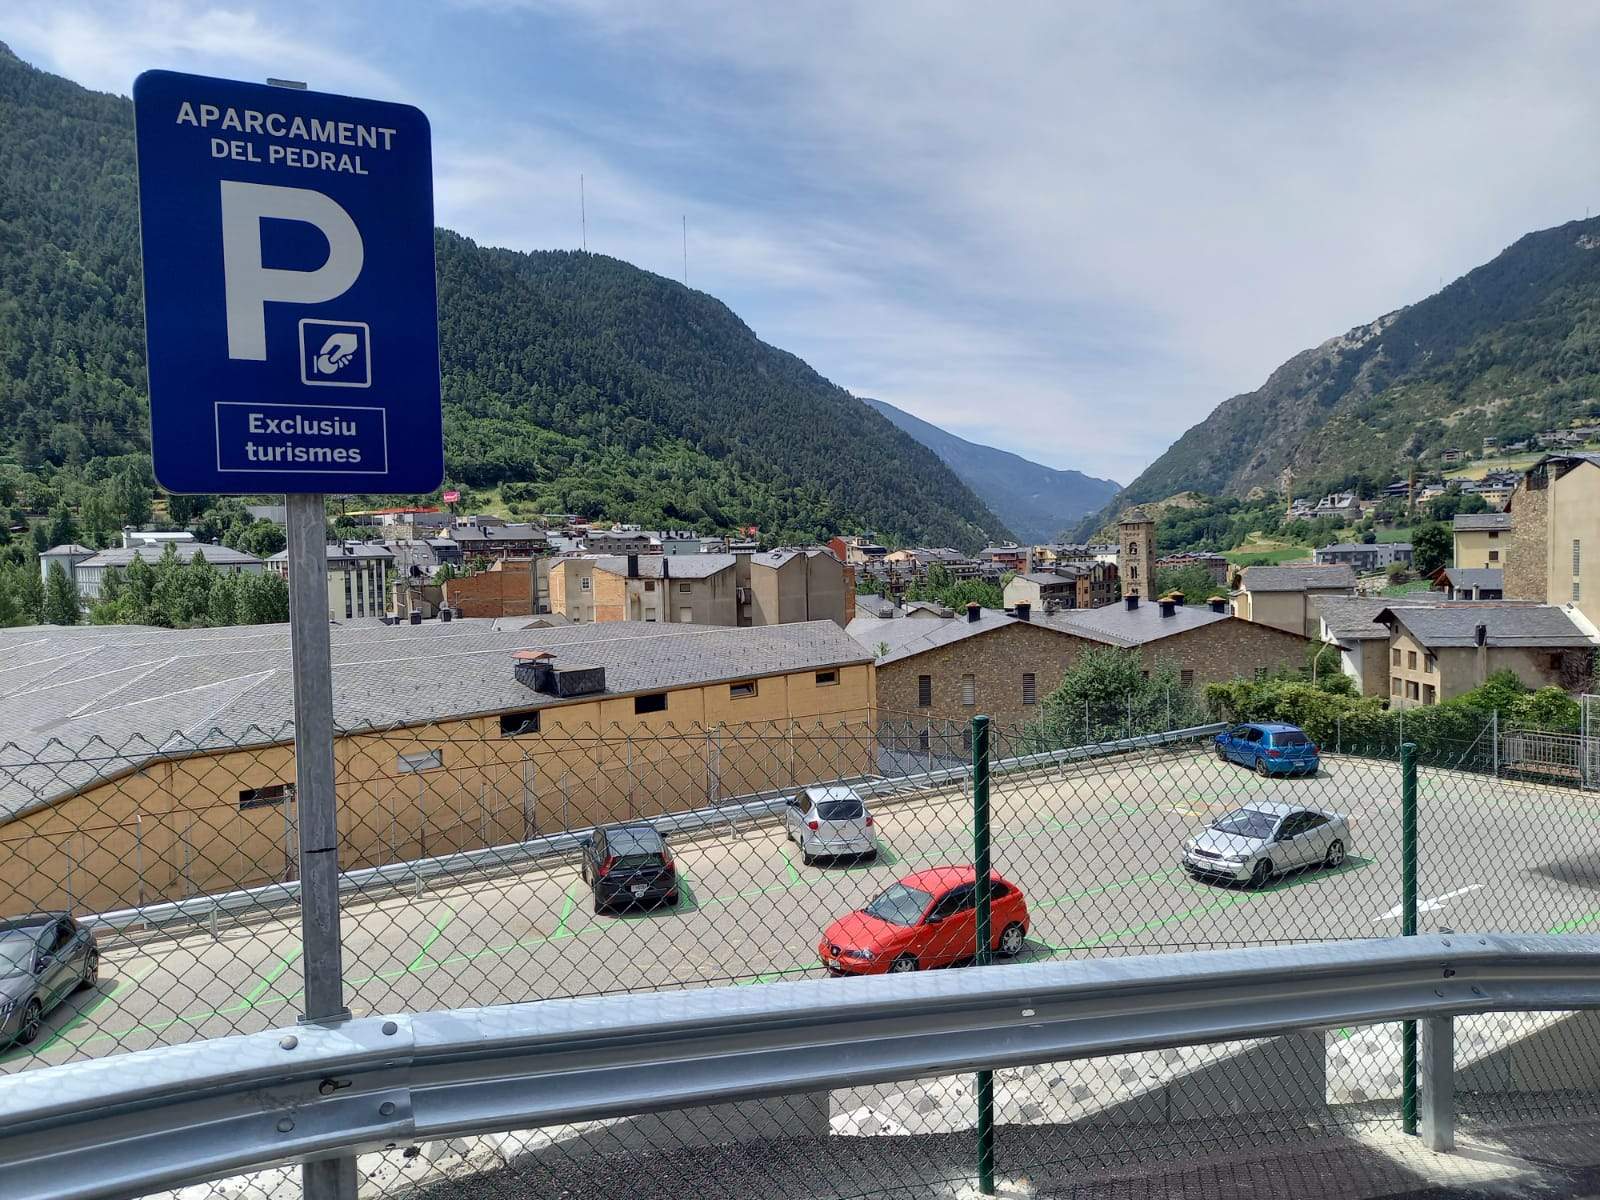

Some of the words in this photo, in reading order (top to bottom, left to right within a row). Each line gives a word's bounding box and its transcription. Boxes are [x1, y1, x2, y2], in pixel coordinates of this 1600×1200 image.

[176, 102, 397, 150] APARCAMENT
[211, 138, 262, 162] DEL
[269, 145, 369, 175] PEDRAL
[220, 180, 364, 361] P
[249, 414, 356, 436] Exclusiu
[245, 441, 361, 463] turismes
